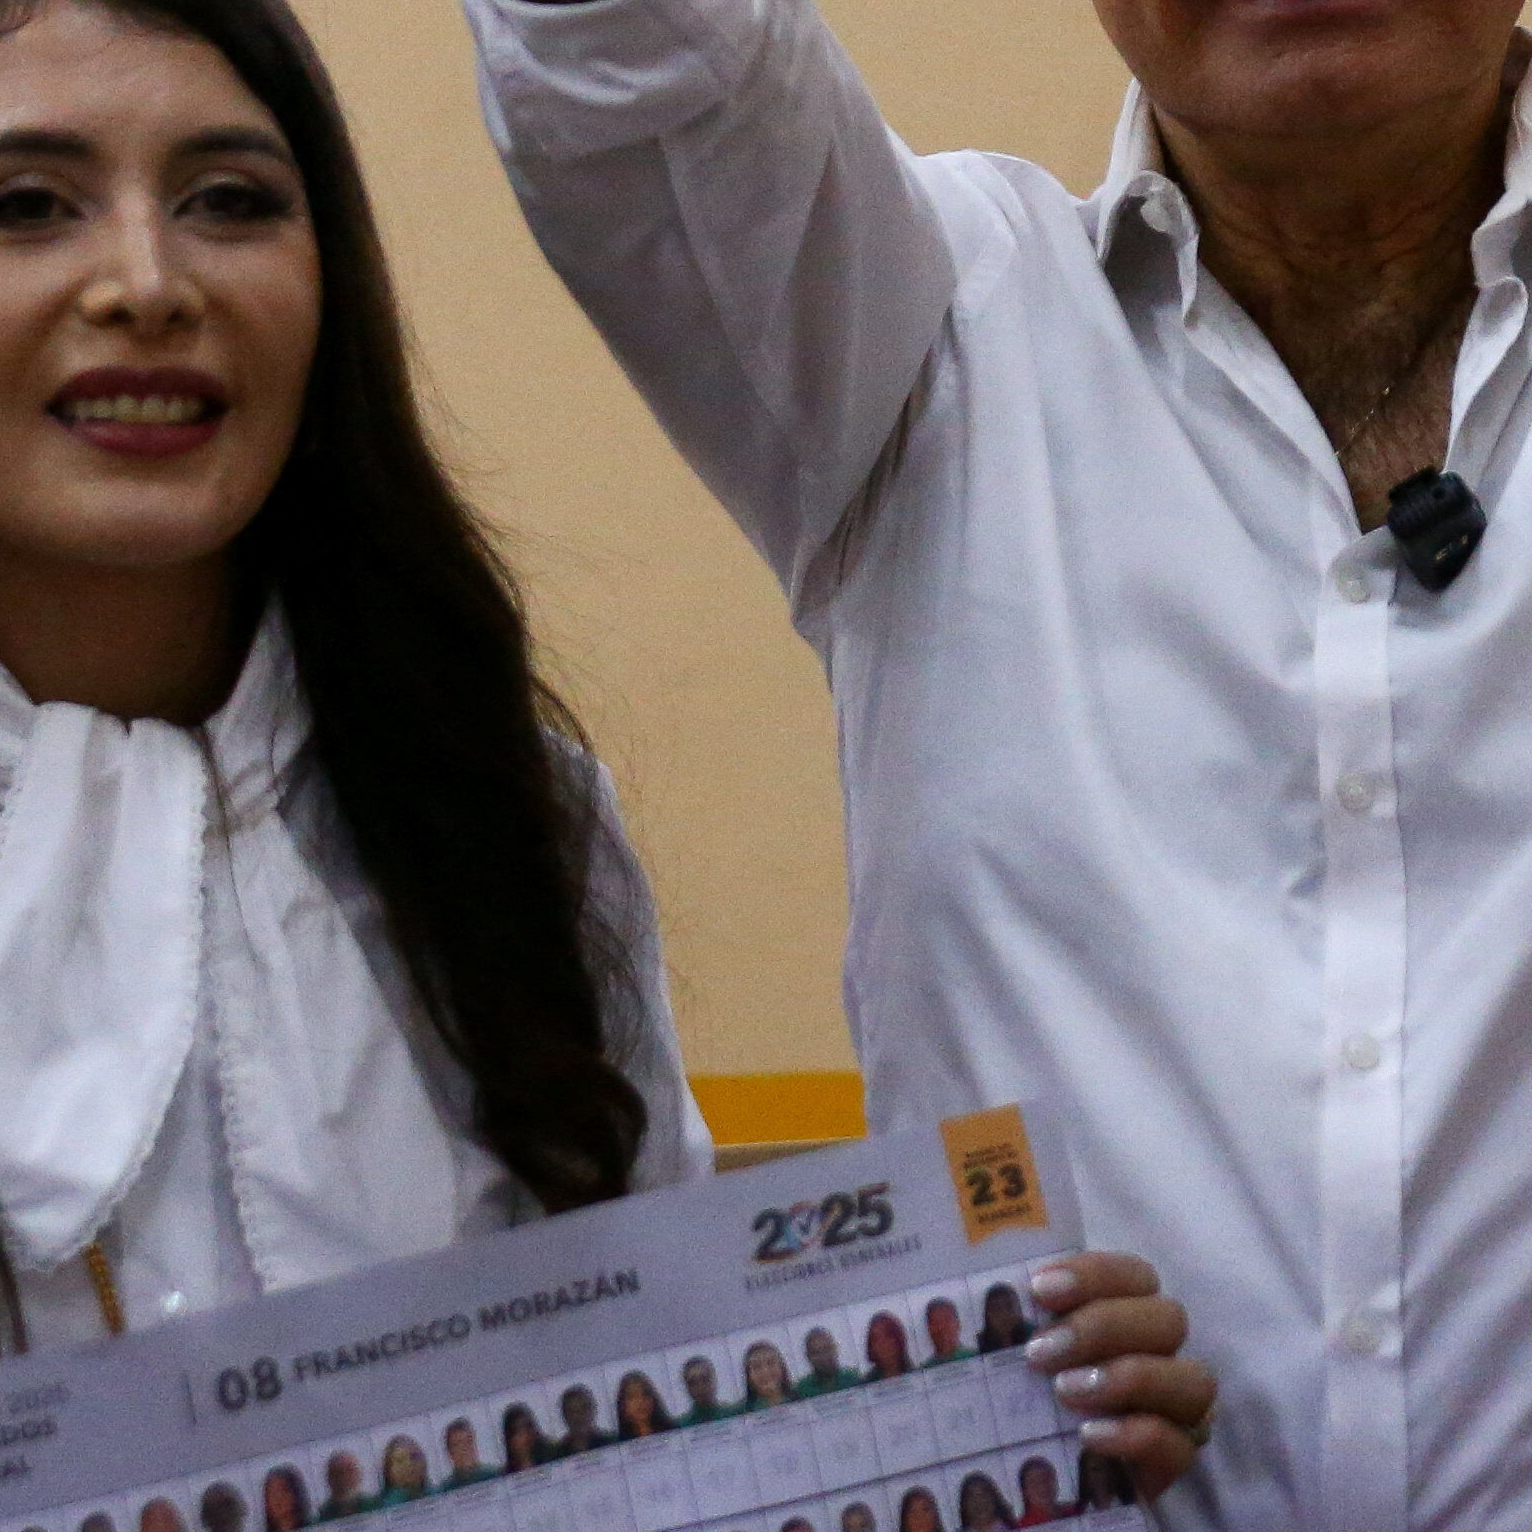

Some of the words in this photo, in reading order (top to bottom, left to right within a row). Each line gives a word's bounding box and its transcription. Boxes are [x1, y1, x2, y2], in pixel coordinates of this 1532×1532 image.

[966, 1163, 1027, 1206] 23
[214, 1354, 285, 1411] 08
[291, 1311, 474, 1384] FRANCISCO
